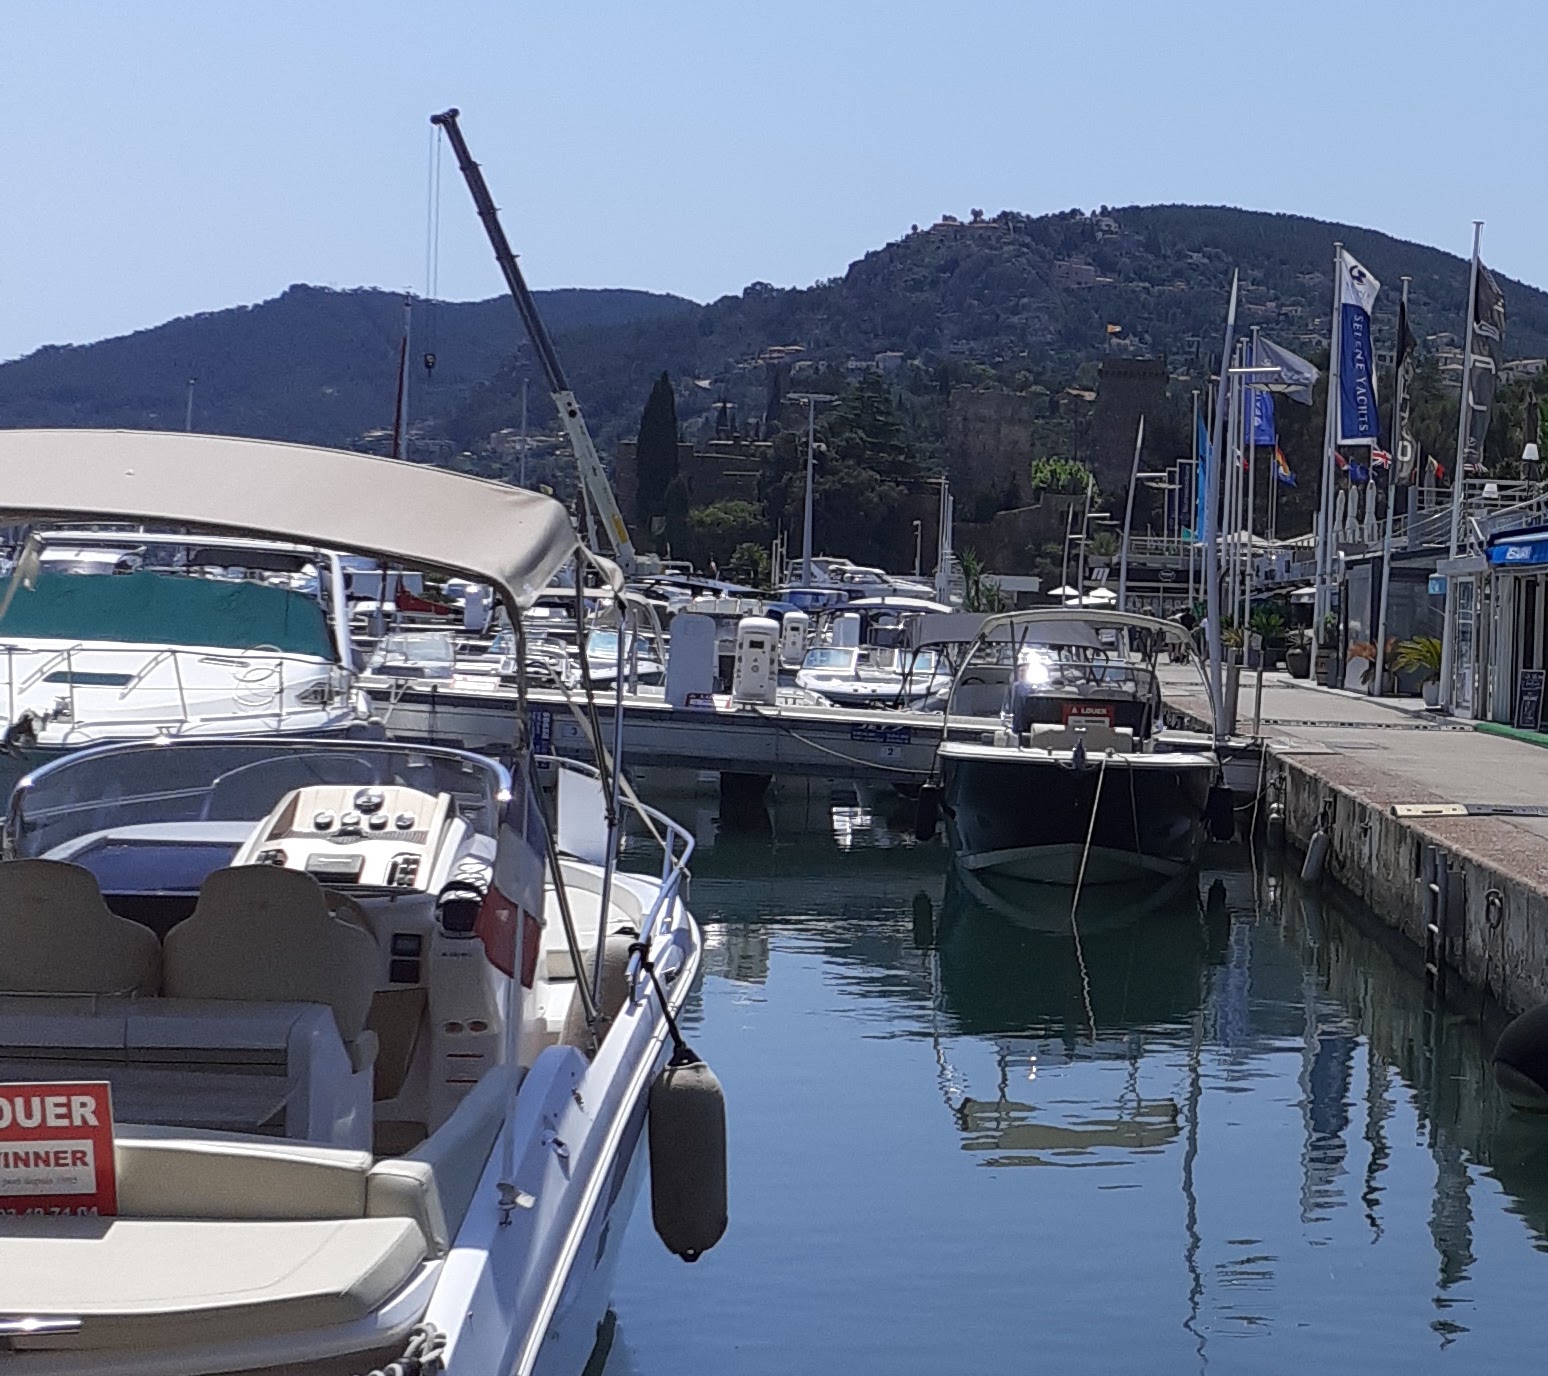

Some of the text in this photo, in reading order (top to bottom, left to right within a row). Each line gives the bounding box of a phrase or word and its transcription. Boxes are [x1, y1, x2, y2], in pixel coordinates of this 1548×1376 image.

[1353, 314, 1366, 371] SELENE
[1355, 376, 1369, 432] YACHTS
[1080, 707, 1107, 715] LOUER
[887, 747, 894, 756] 2
[0, 1150, 89, 1169] INNER
